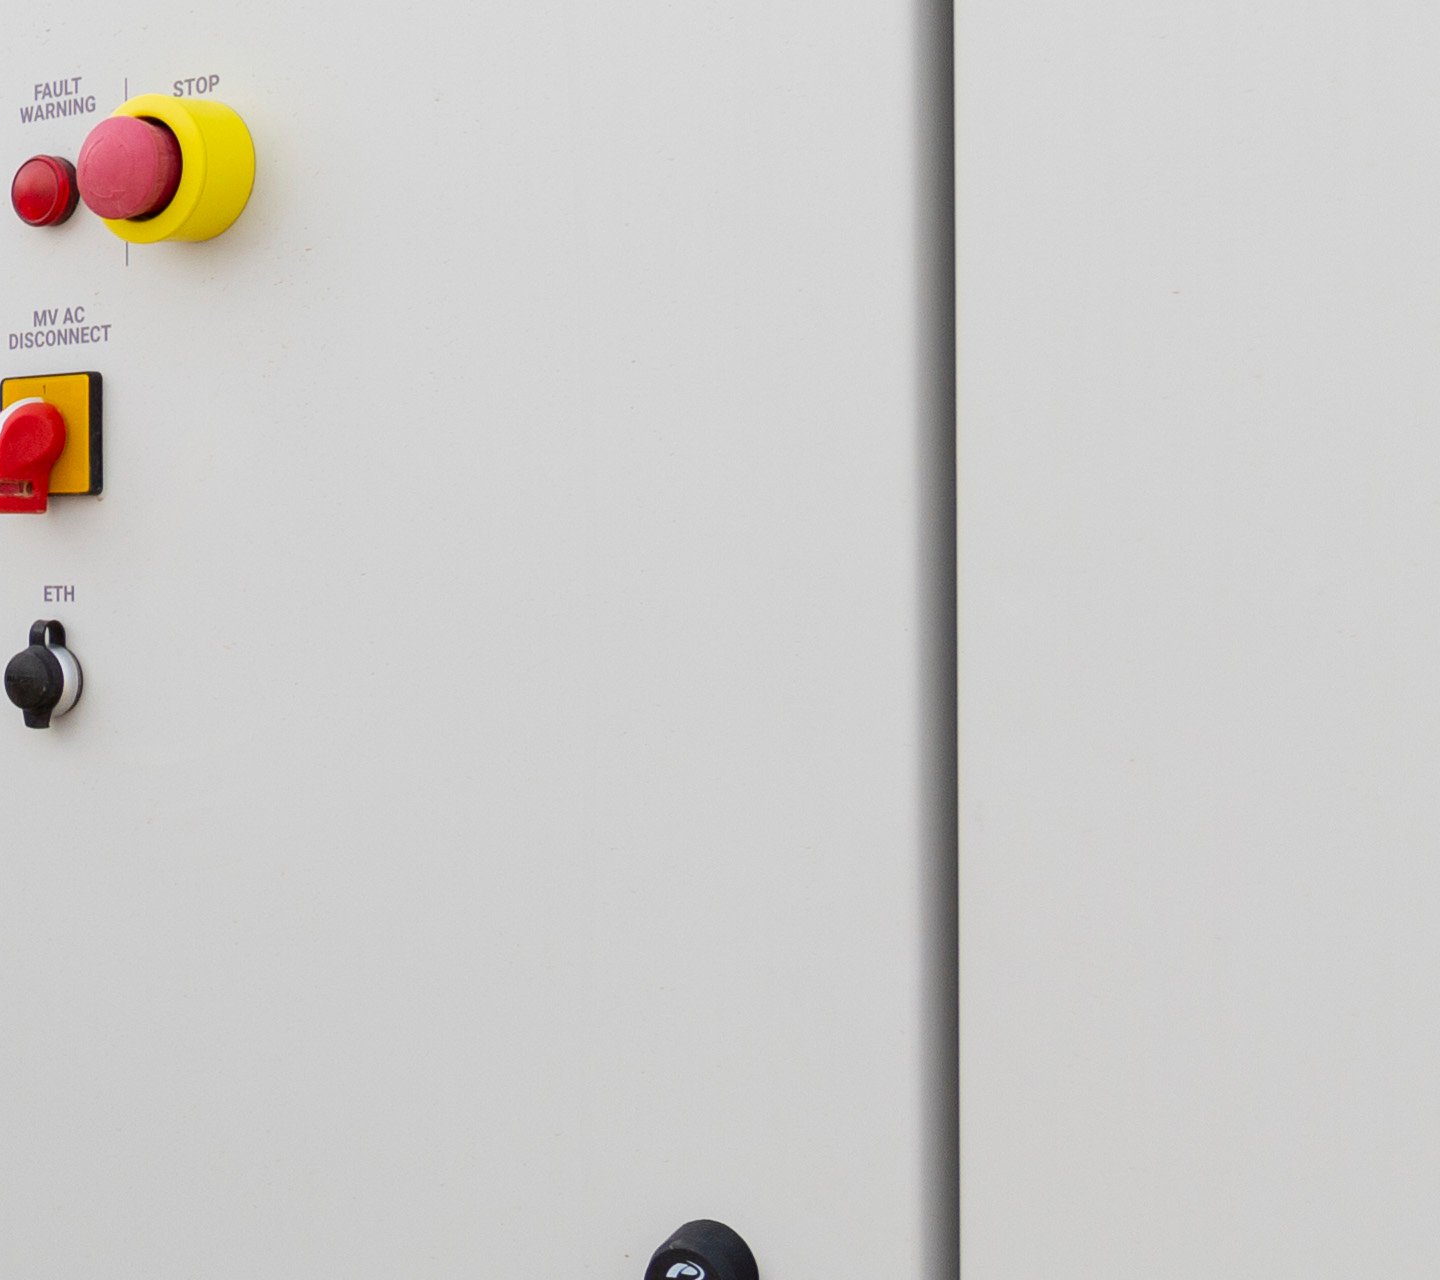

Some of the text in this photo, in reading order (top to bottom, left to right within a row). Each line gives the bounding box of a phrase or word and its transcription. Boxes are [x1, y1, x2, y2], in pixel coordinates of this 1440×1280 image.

[34, 77, 83, 101] FAULT
[172, 74, 220, 98] STOP
[20, 95, 97, 124] WARNING
[33, 306, 86, 328] MV AC
[8, 324, 112, 350] DISCONNECT
[43, 585, 75, 603] ETH
